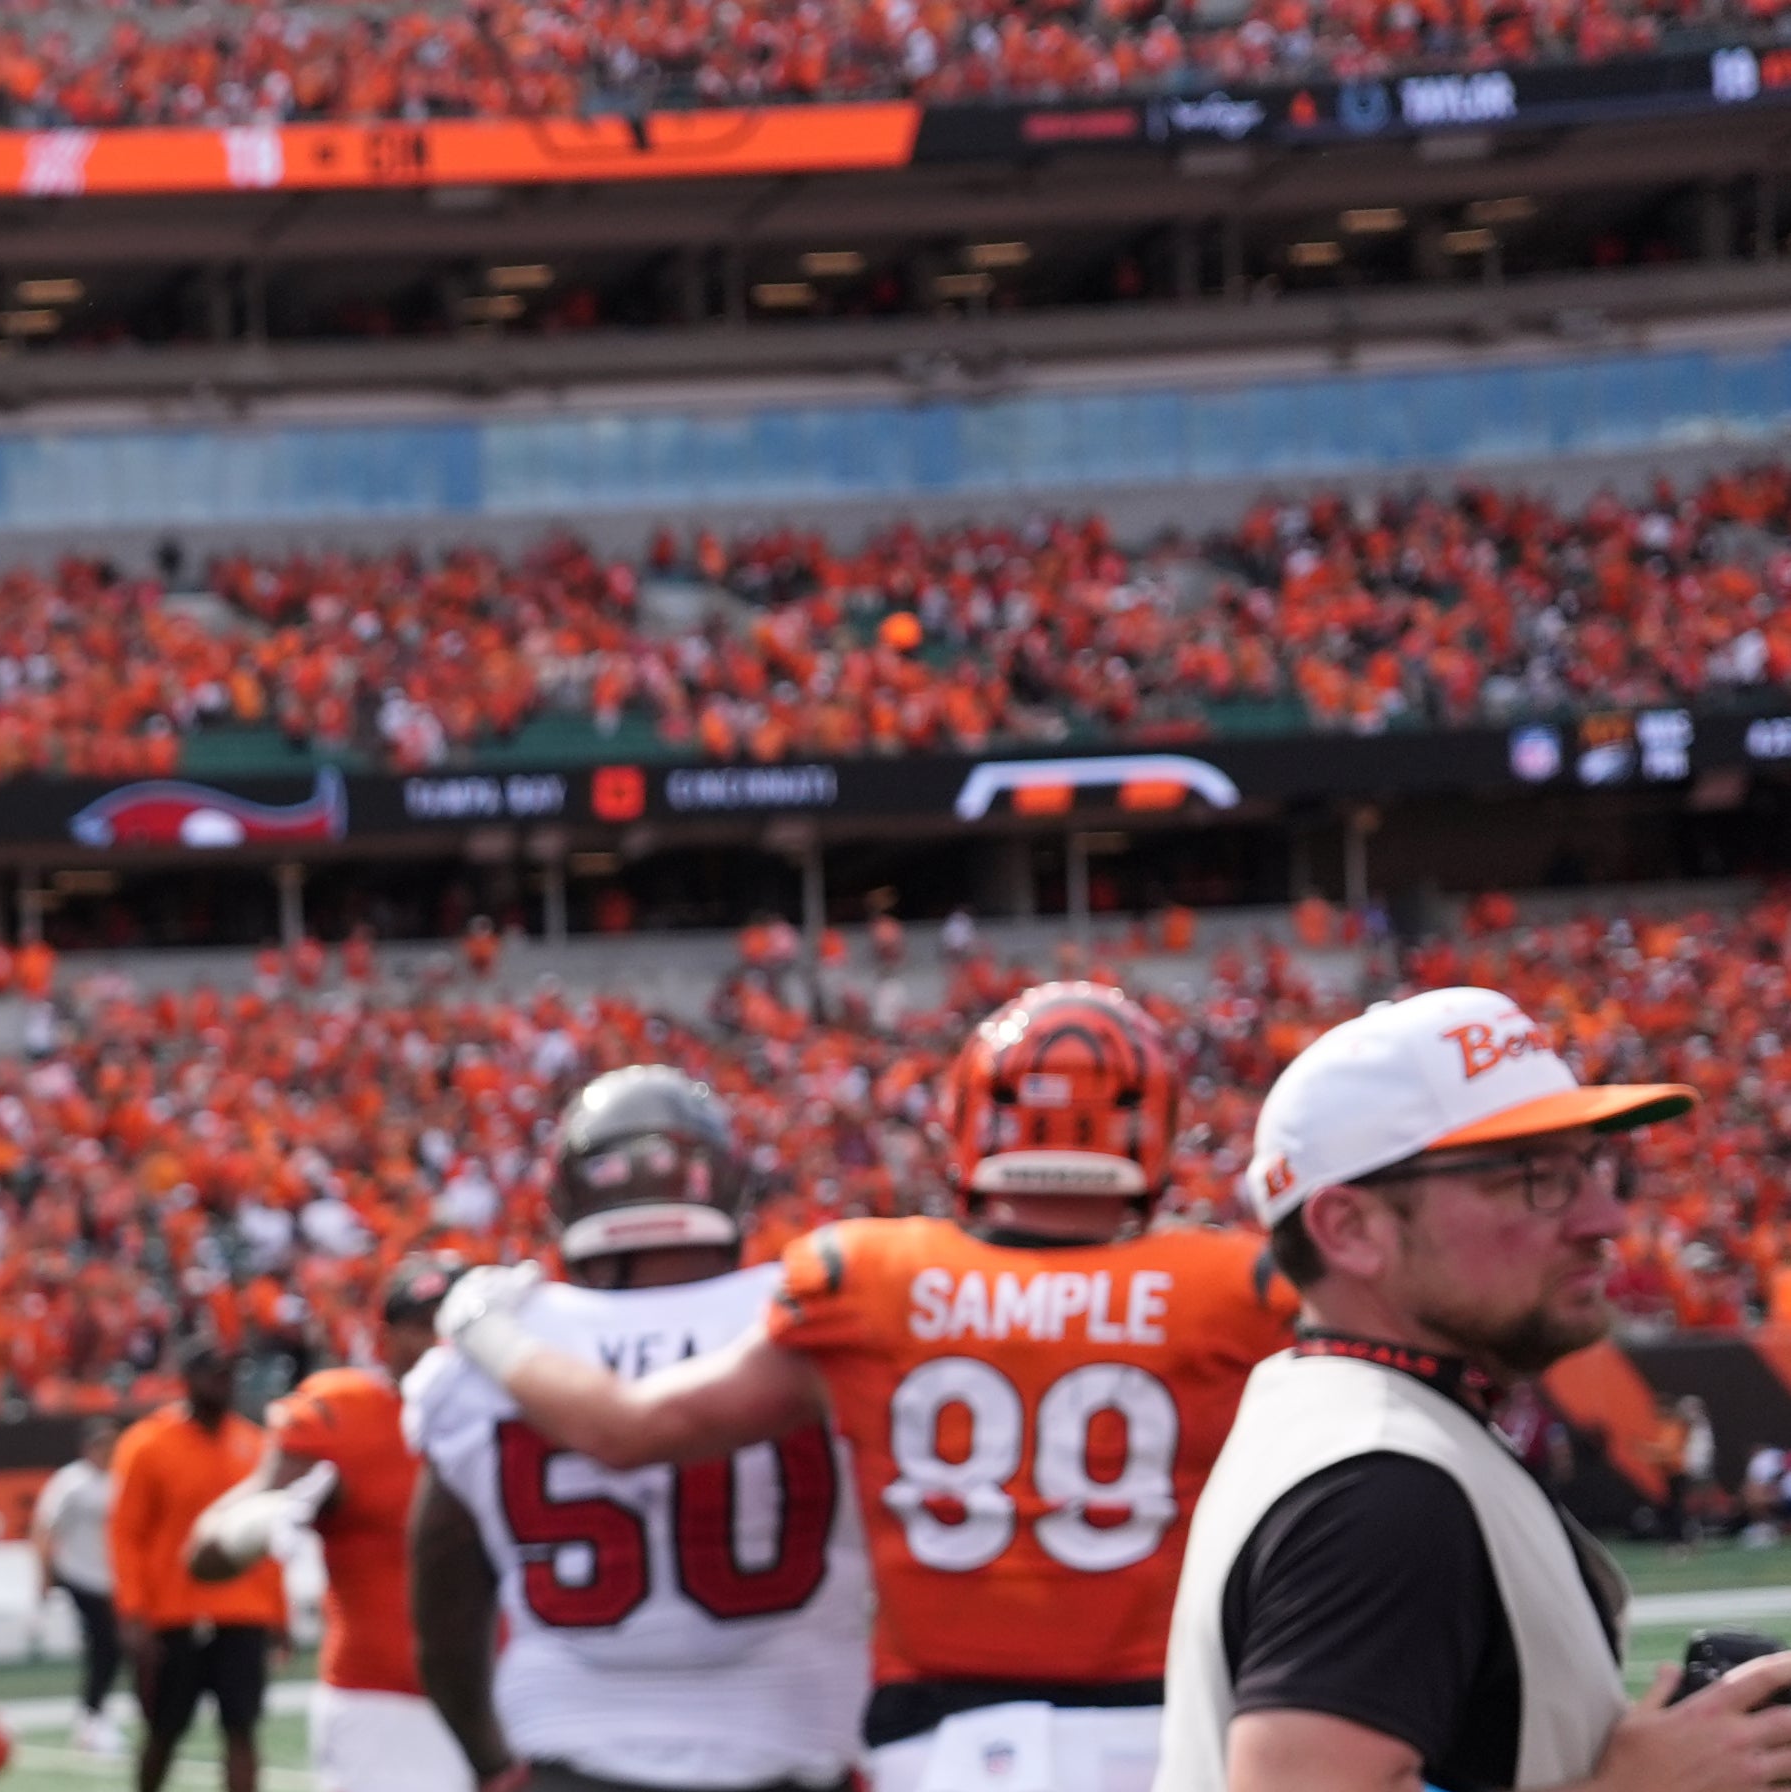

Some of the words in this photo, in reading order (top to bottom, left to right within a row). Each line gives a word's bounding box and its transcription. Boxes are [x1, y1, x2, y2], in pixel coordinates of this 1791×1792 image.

[909, 1267, 1173, 1346] SAMPLE
[497, 1415, 839, 1628] 50
[885, 1354, 1181, 1574] 89
